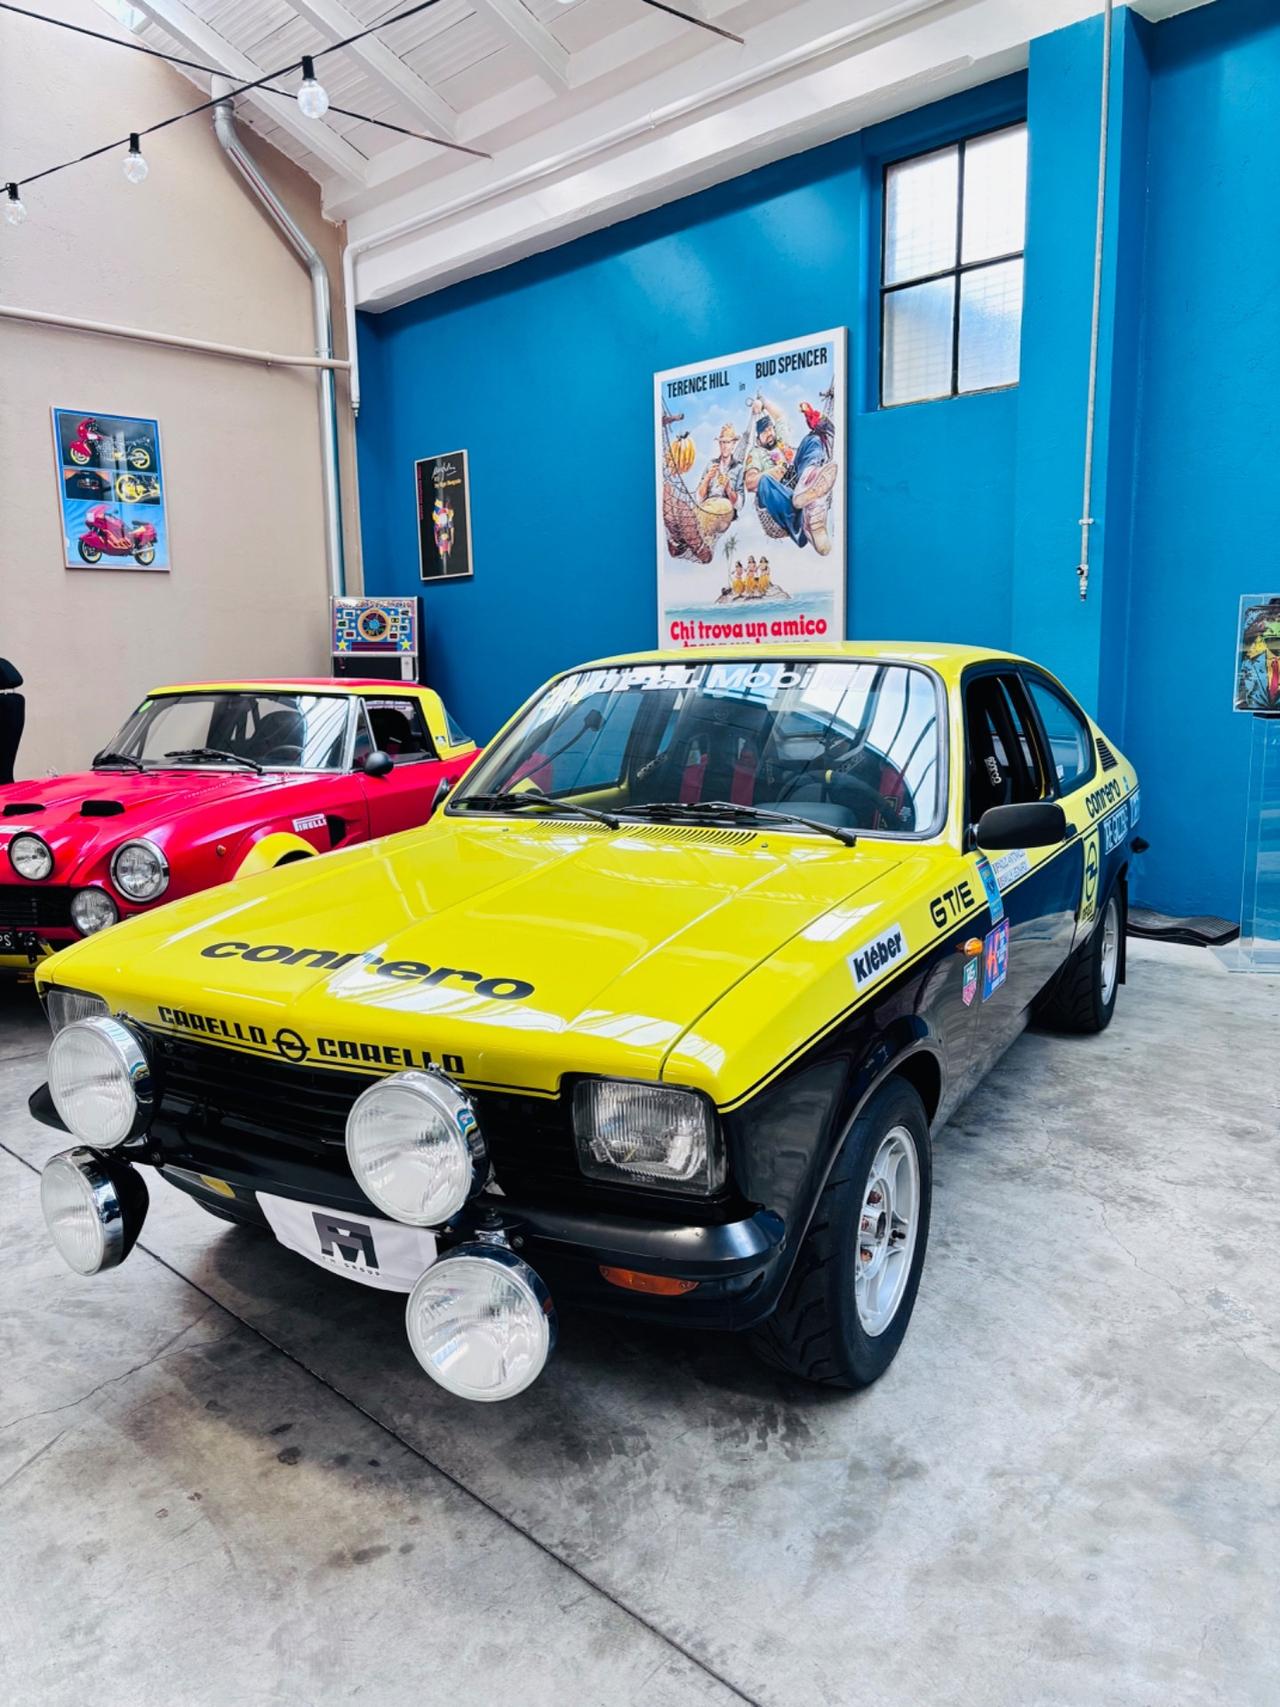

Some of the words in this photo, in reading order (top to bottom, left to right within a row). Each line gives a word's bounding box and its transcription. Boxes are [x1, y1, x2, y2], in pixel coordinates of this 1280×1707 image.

[755, 358, 776, 379] BUD
[778, 347, 828, 374] SPENCER
[666, 376, 707, 399] TERENCE
[708, 370, 730, 389] HILL
[738, 382, 746, 392] in
[670, 619, 695, 640] Chi
[699, 620, 743, 639] trova
[745, 622, 768, 638] un
[770, 614, 828, 636] amico
[705, 667, 815, 691] Mobi
[1085, 778, 1121, 819] conrero
[929, 880, 975, 929] GT/E
[200, 941, 535, 1001] conrero
[158, 1005, 267, 1045] CARELLO
[318, 1038, 465, 1074] CARELLO
